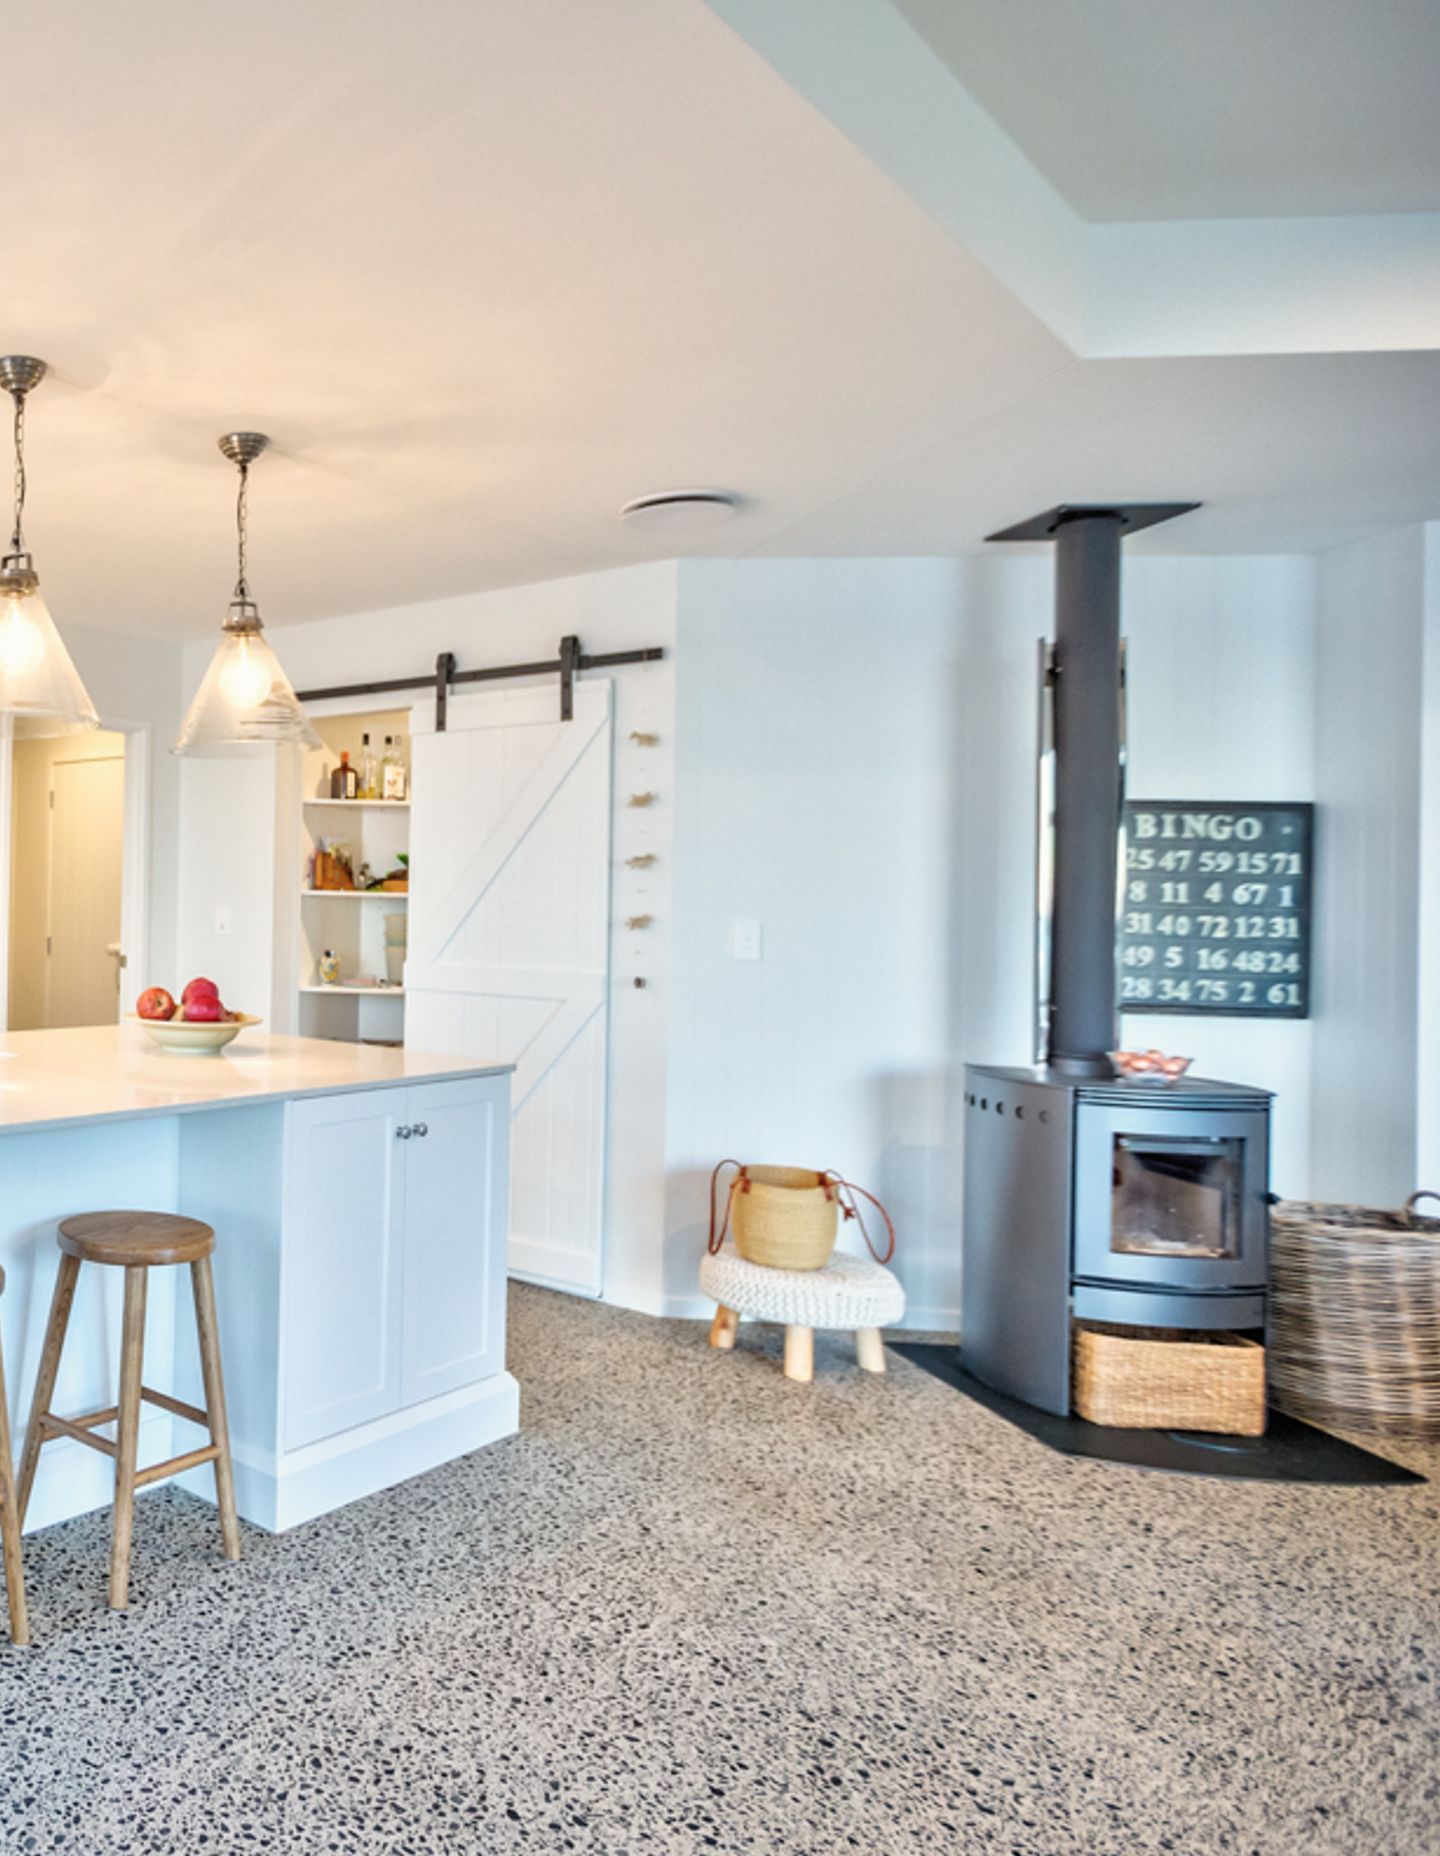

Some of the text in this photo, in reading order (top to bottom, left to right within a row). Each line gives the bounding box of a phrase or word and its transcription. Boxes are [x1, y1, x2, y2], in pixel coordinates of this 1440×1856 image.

[1134, 814, 1263, 840] BINGO
[1127, 848, 1302, 874] 25 47 59 15 71
[1128, 881, 1294, 907] 8 11 4 67 1
[1124, 912, 1300, 938] 31 40 72 12 31
[1121, 945, 1302, 973] 49 5 16 48 24
[1121, 976, 1301, 1006] 28 34 75 2 61
